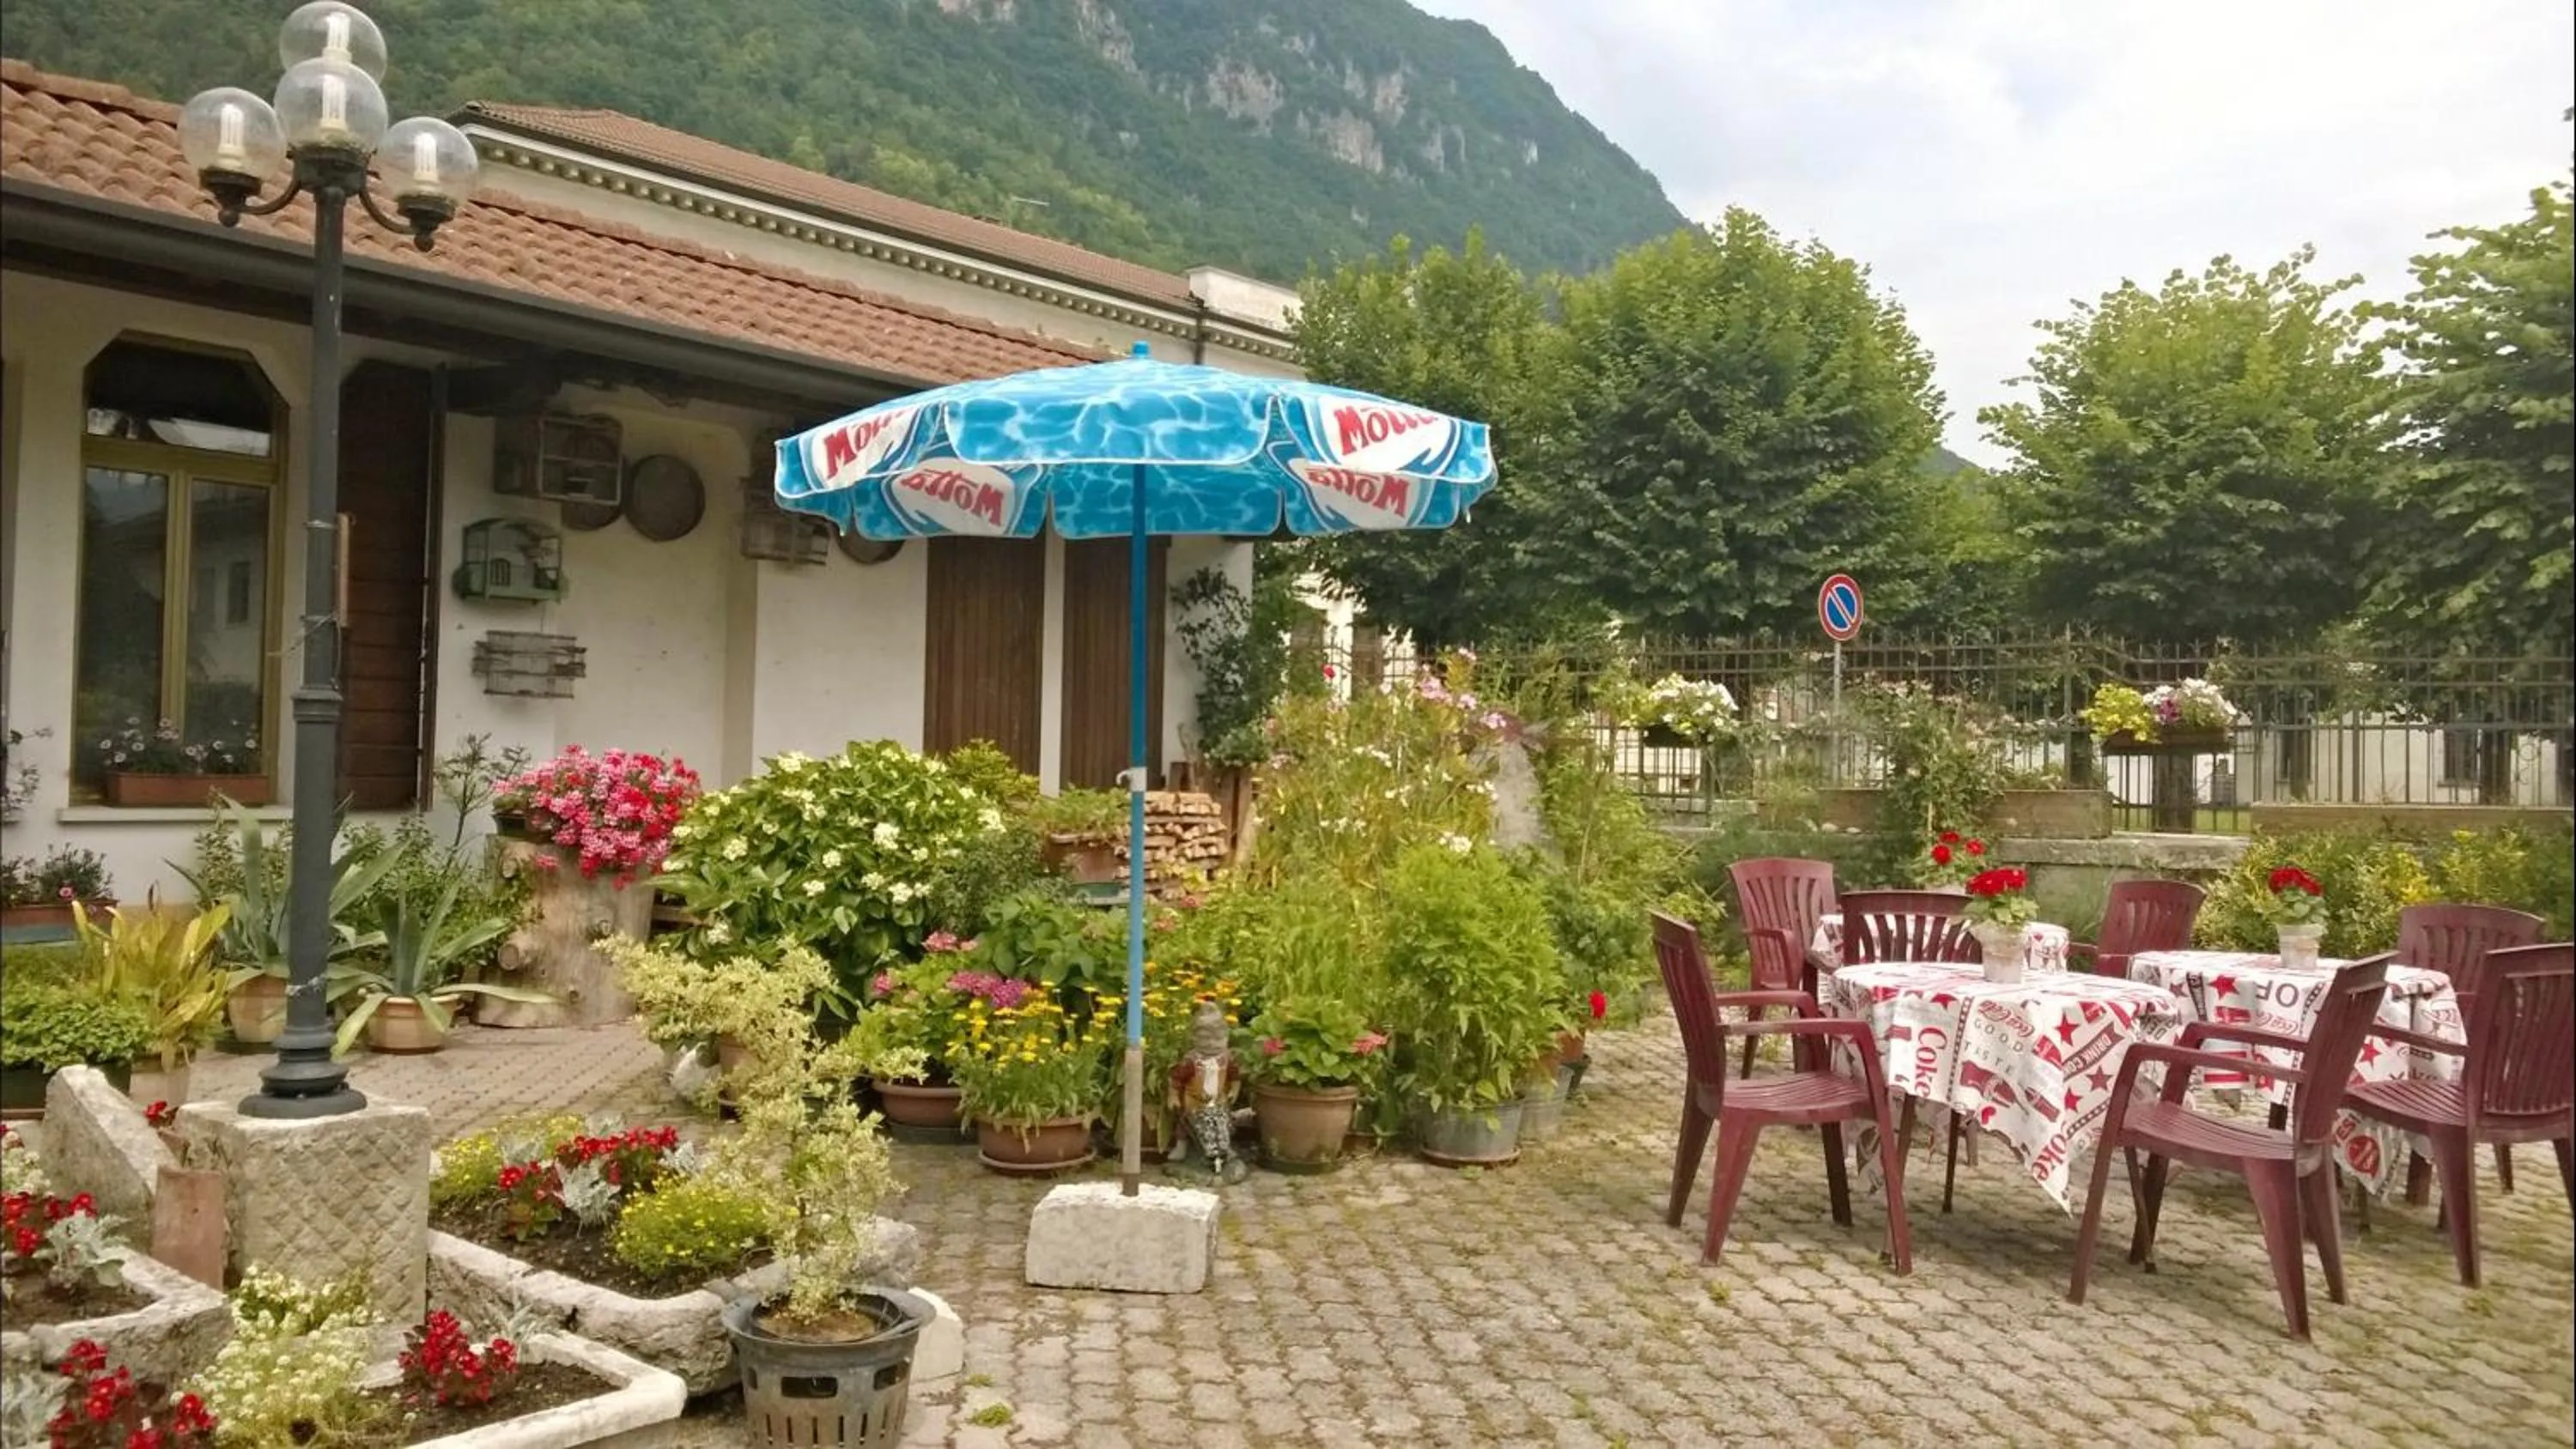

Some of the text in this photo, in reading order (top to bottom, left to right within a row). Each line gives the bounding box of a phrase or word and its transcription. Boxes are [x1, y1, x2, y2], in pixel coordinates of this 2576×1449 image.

[1974, 1018, 2024, 1052] GOOD
[2081, 1033, 2112, 1063] DRINK
[1914, 1027, 1947, 1098] Coke
